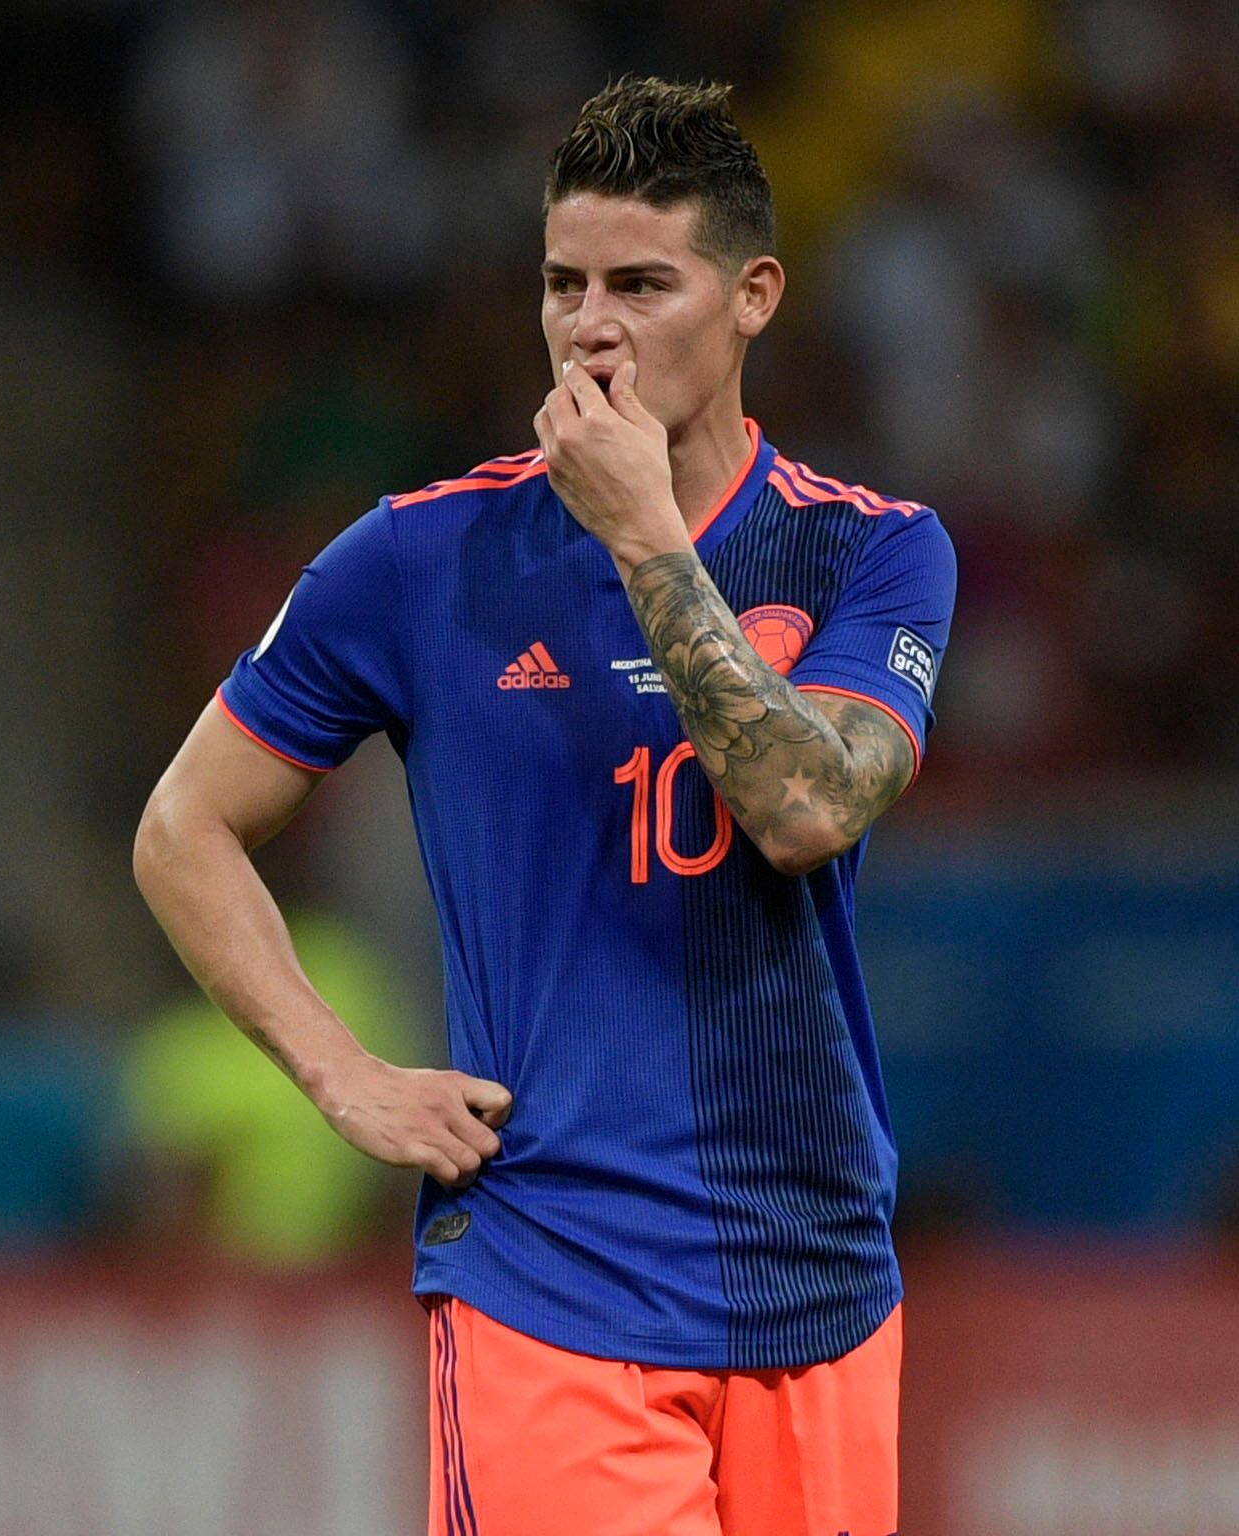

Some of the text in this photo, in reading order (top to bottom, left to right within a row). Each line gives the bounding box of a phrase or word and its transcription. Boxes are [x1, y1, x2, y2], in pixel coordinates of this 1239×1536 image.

[899, 636, 932, 672] Cree
[496, 670, 571, 691] adidas
[628, 673, 640, 684] 15
[614, 741, 733, 884] 10
